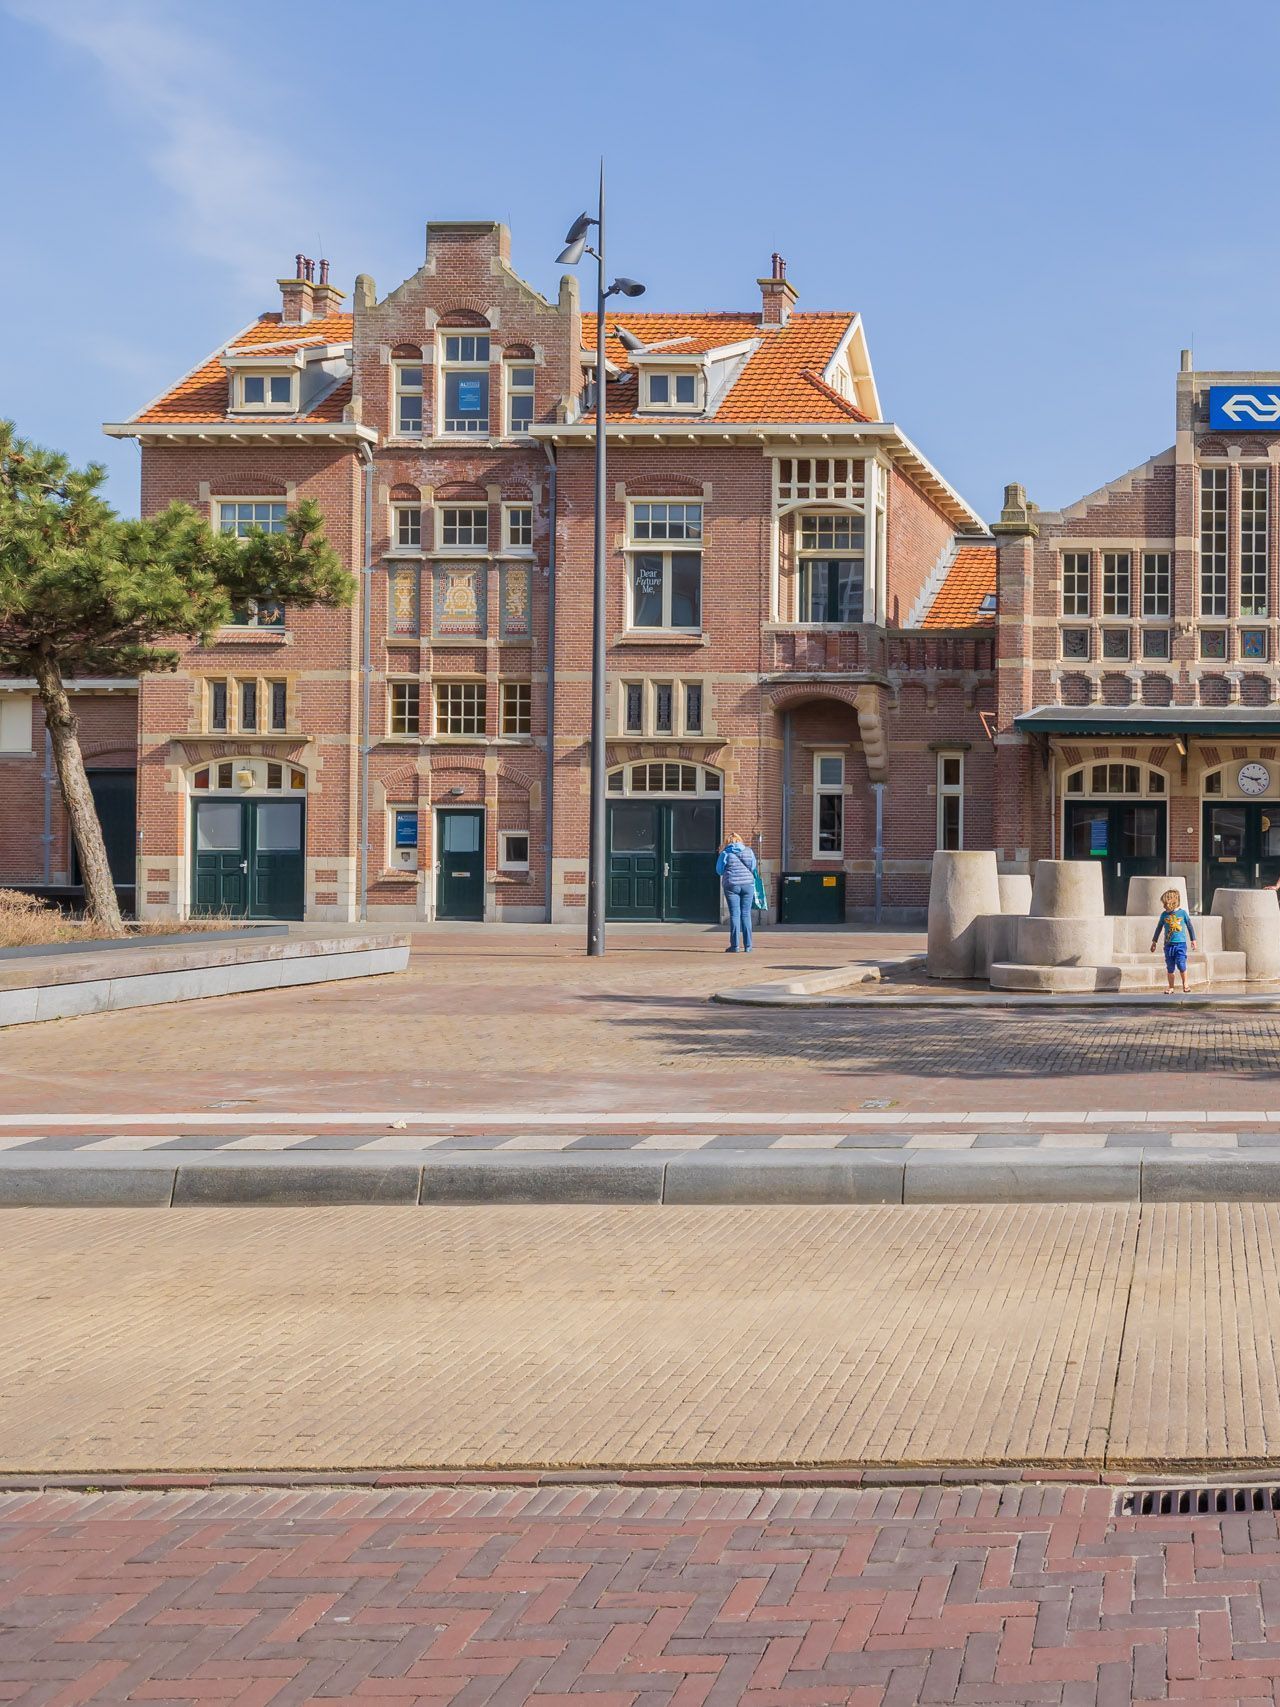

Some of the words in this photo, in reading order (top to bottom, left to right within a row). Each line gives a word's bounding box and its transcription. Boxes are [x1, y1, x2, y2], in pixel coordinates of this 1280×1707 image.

[639, 569, 658, 578] Dear
[635, 577, 662, 586] Future
[642, 585, 656, 595] Me,
